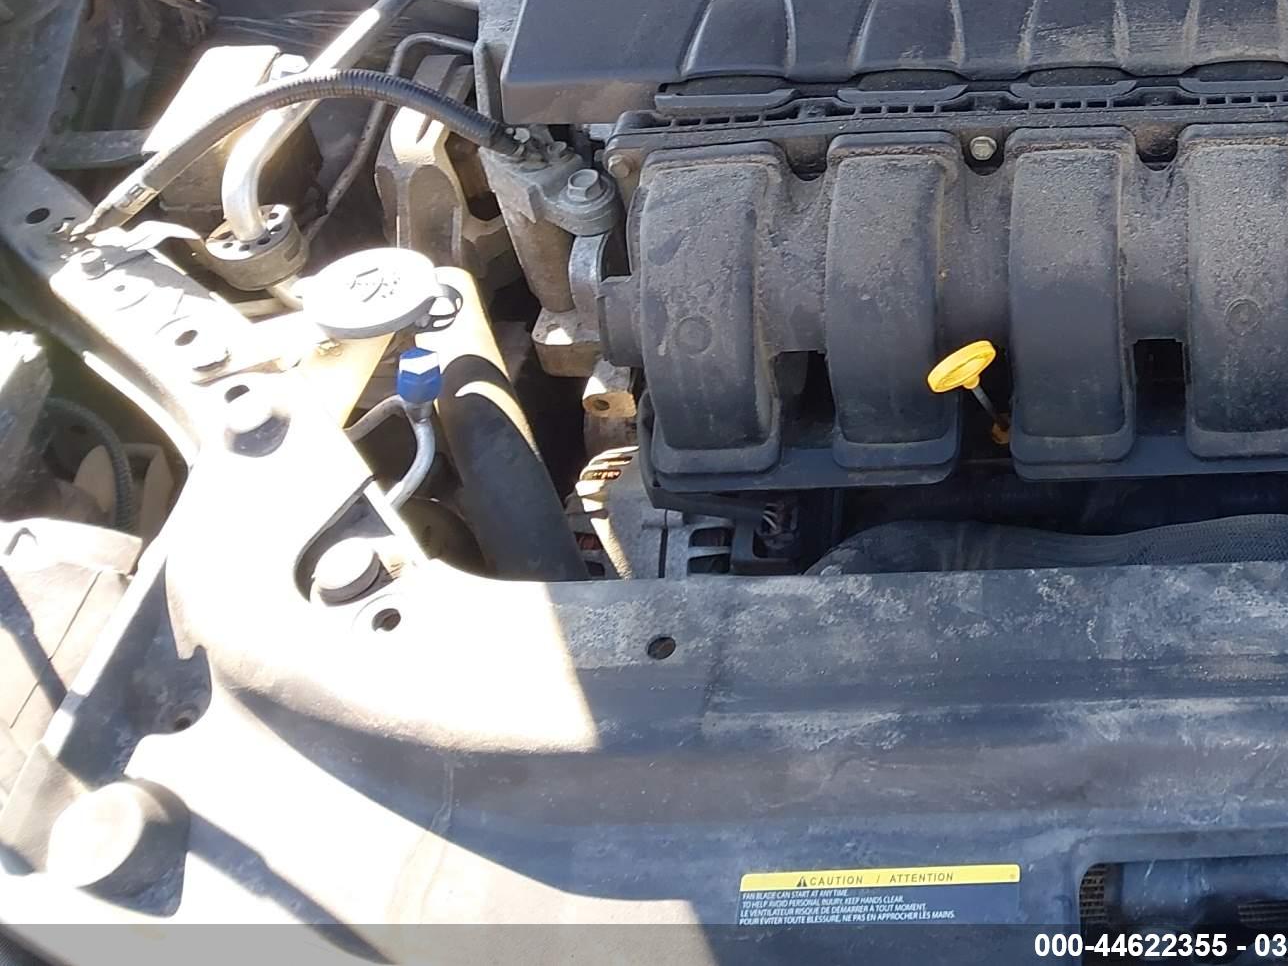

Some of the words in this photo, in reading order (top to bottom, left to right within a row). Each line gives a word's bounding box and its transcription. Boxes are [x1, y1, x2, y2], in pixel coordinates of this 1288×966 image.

[809, 875, 863, 886] CAUTION
[889, 872, 954, 883] ATTENTION
[742, 892, 755, 901] FAN
[756, 891, 776, 900] BLADE
[777, 891, 790, 899] CAN
[791, 890, 810, 899] START
[820, 889, 833, 897] ANY
[743, 900, 752, 908] TO
[752, 900, 768, 908] HELP
[769, 899, 788, 907] AVOID
[789, 898, 820, 907] PERSONAL
[844, 897, 860, 905] KEEP
[860, 896, 882, 905] HANDS
[741, 909, 748, 917] LE
[749, 907, 794, 917] VENTILATEUR
[795, 906, 819, 915] RISQUE
[821, 906, 830, 914] DE
[876, 903, 894, 912] TOUT
[739, 917, 759, 926] POUR
[783, 915, 805, 924] TOUTE
[842, 913, 852, 922] NE
[853, 913, 866, 922] PAS
[866, 913, 877, 921] EN
[877, 912, 918, 921] APPROCHER
[919, 911, 930, 920] LES
